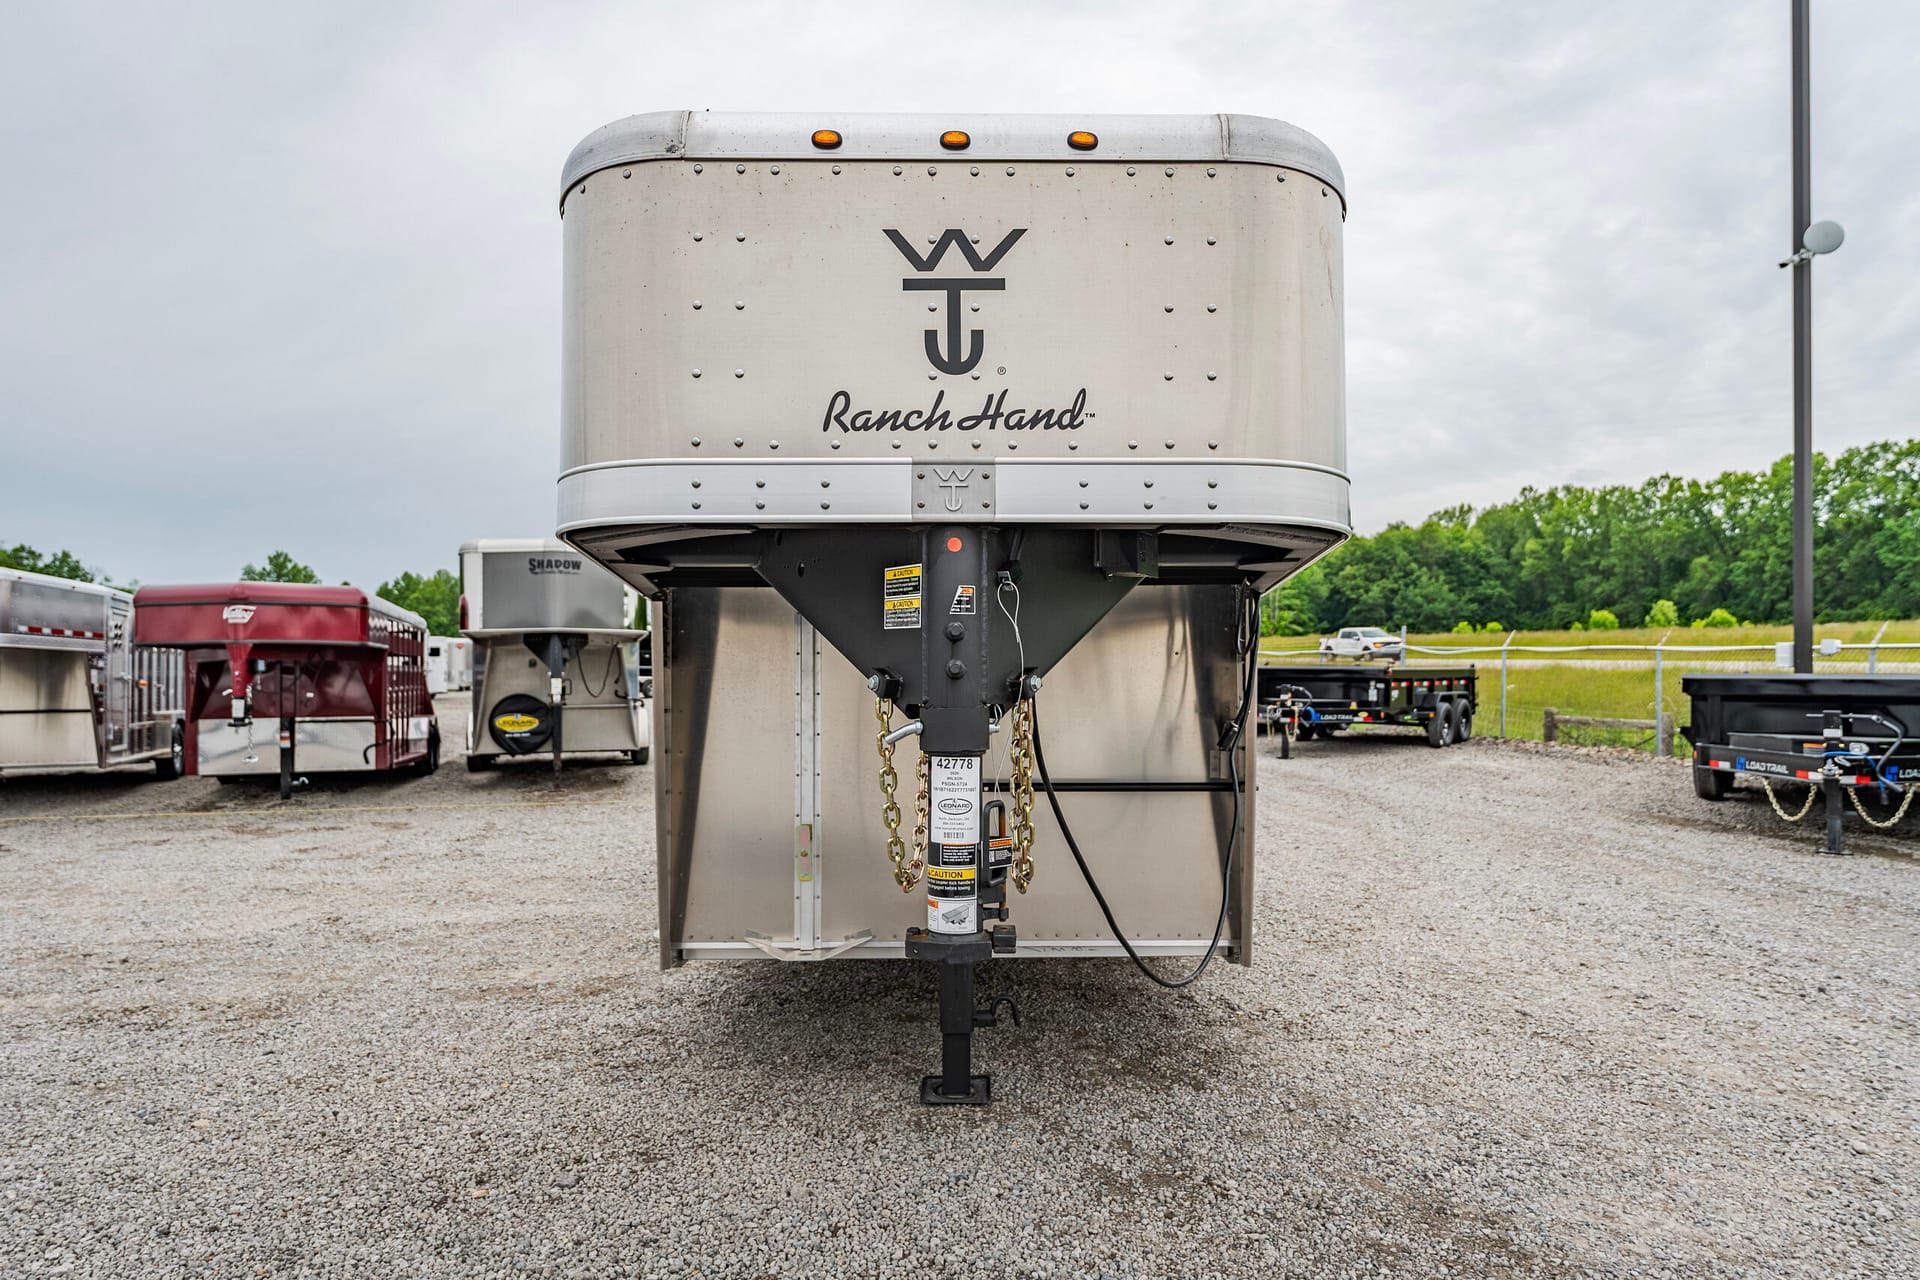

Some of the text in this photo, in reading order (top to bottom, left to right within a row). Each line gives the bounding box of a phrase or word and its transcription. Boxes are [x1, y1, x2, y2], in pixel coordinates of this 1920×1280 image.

[822, 389, 953, 433] Ranch
[936, 758, 973, 769] 42778
[930, 869, 963, 879] CAUTION
